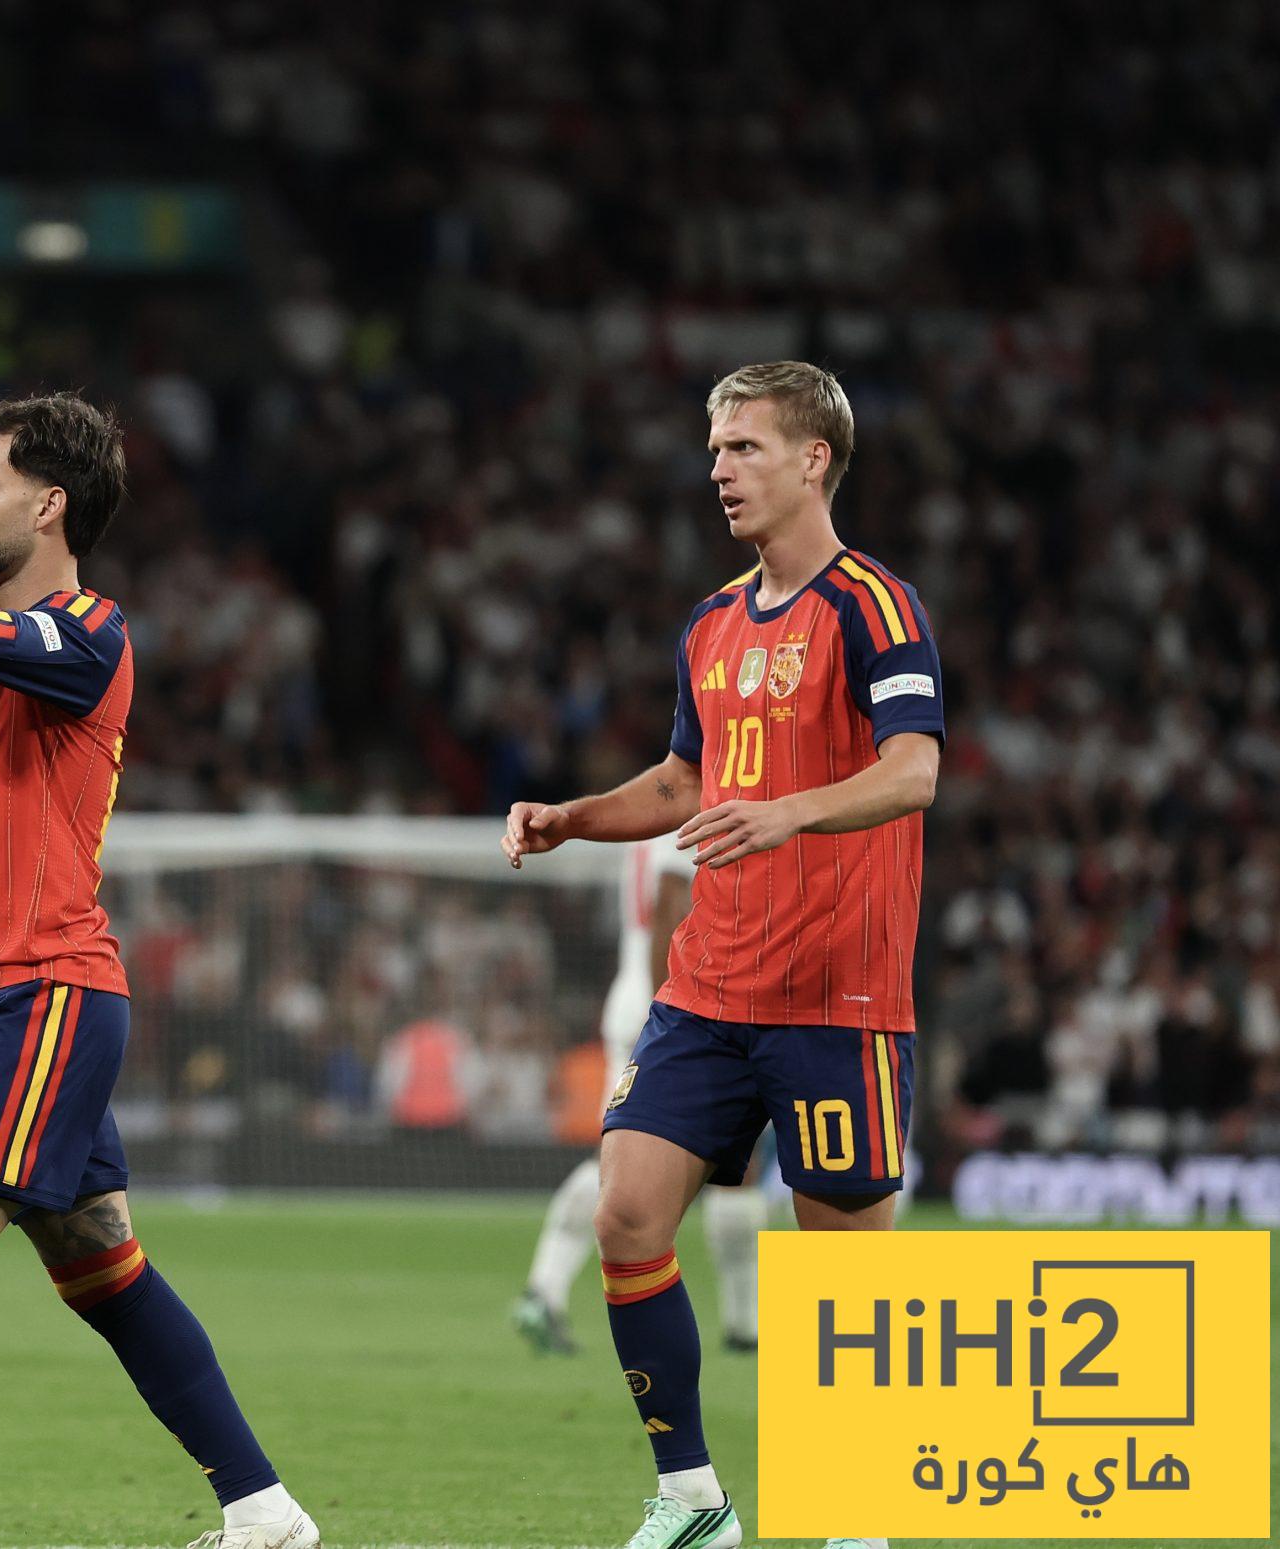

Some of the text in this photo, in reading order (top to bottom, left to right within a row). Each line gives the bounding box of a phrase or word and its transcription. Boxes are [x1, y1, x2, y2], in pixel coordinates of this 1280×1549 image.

[872, 680, 933, 696] FOUNDATION
[720, 716, 764, 788] 10
[793, 1099, 856, 1171] 10
